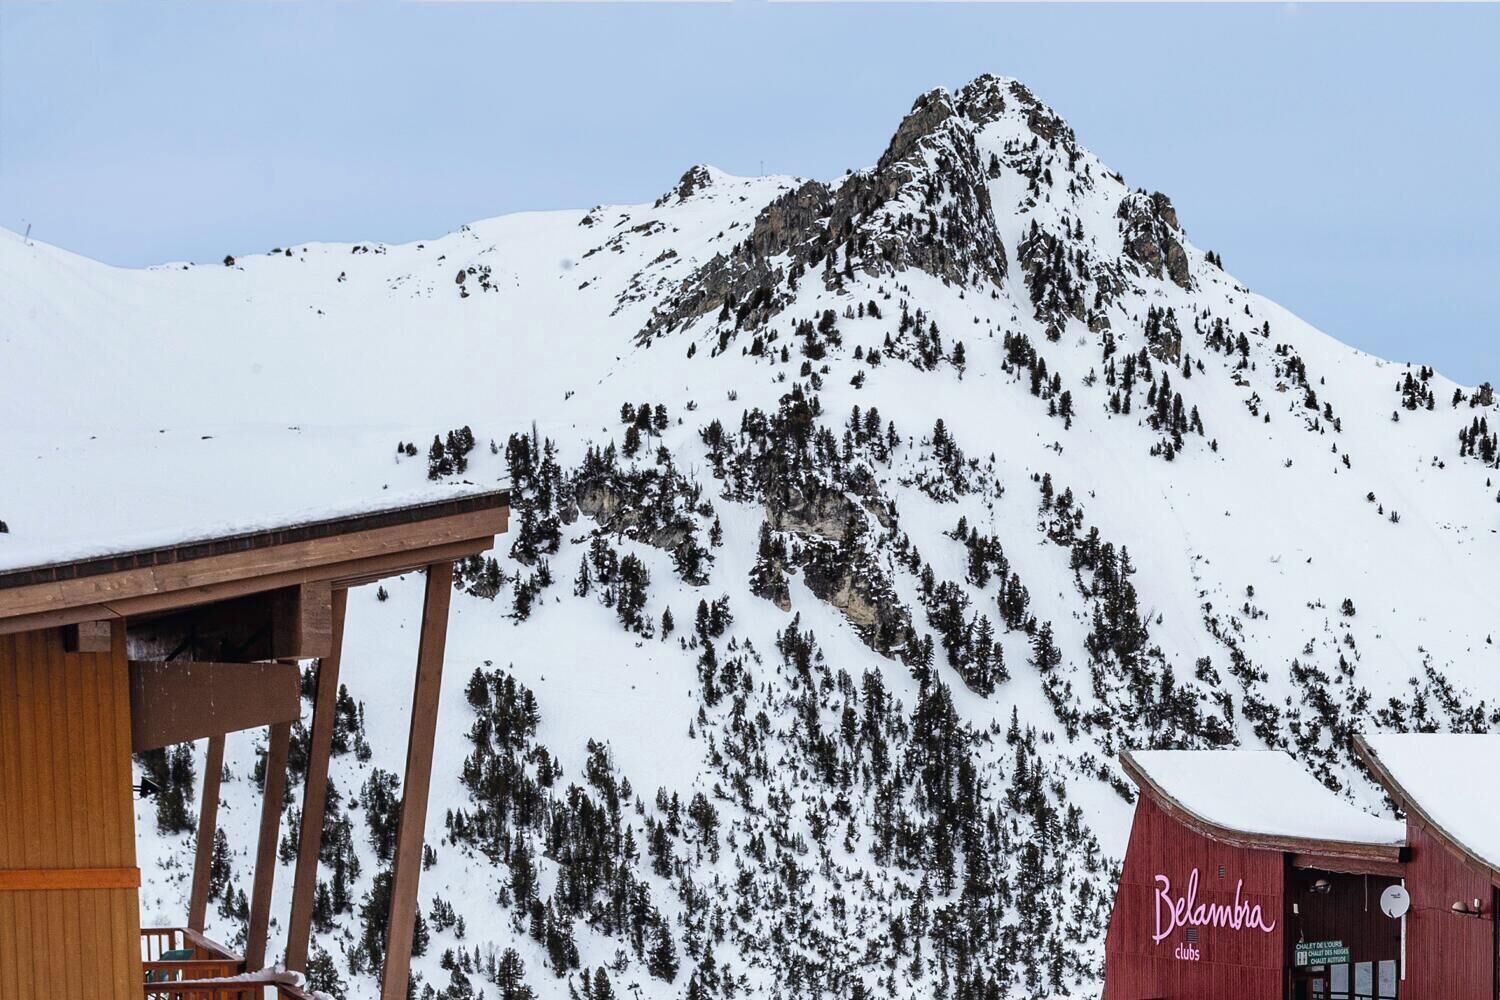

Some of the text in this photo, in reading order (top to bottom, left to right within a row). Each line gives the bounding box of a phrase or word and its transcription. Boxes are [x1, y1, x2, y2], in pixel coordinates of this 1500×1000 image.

[1152, 867, 1276, 946] Belambra
[1175, 942, 1200, 961] clubs
[1316, 942, 1323, 950] DE
[1310, 957, 1327, 965] CHALET
